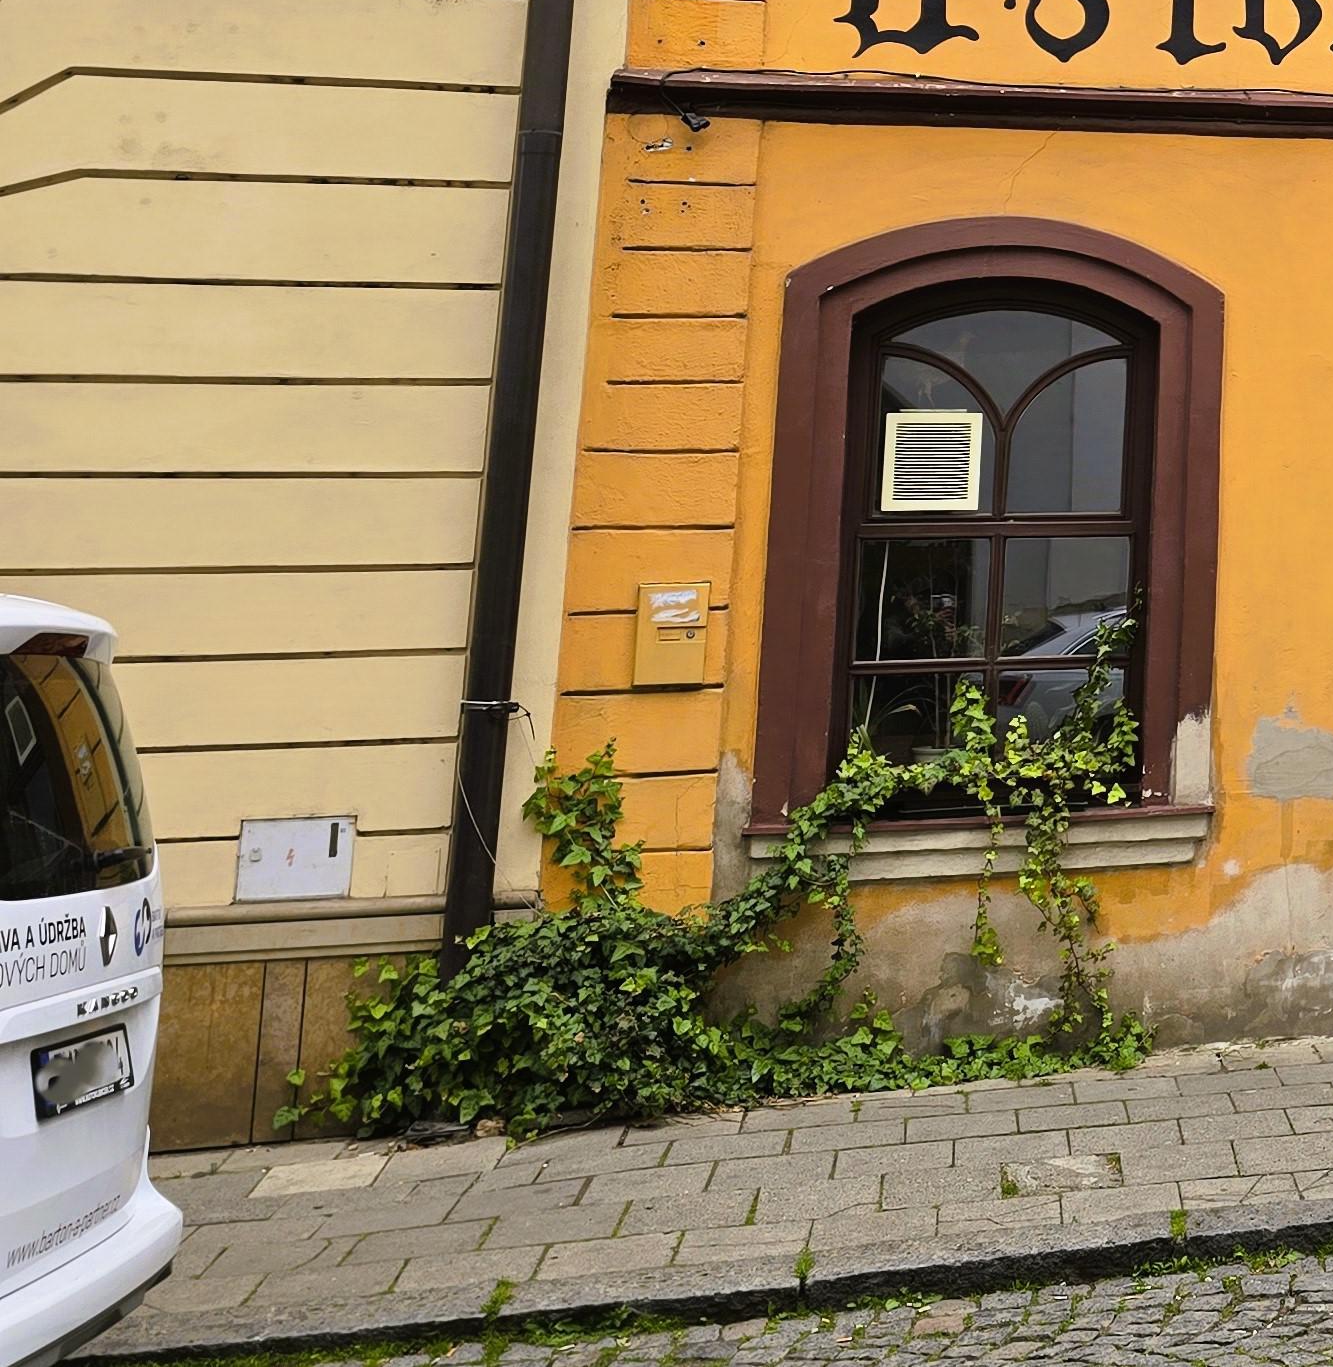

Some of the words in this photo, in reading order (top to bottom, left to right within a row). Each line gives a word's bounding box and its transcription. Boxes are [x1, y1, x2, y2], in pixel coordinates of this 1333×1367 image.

[0, 927, 21, 953] VA
[25, 925, 35, 949] A
[38, 913, 87, 946] ÚDRŽBA
[49, 939, 86, 978] DOMŮ
